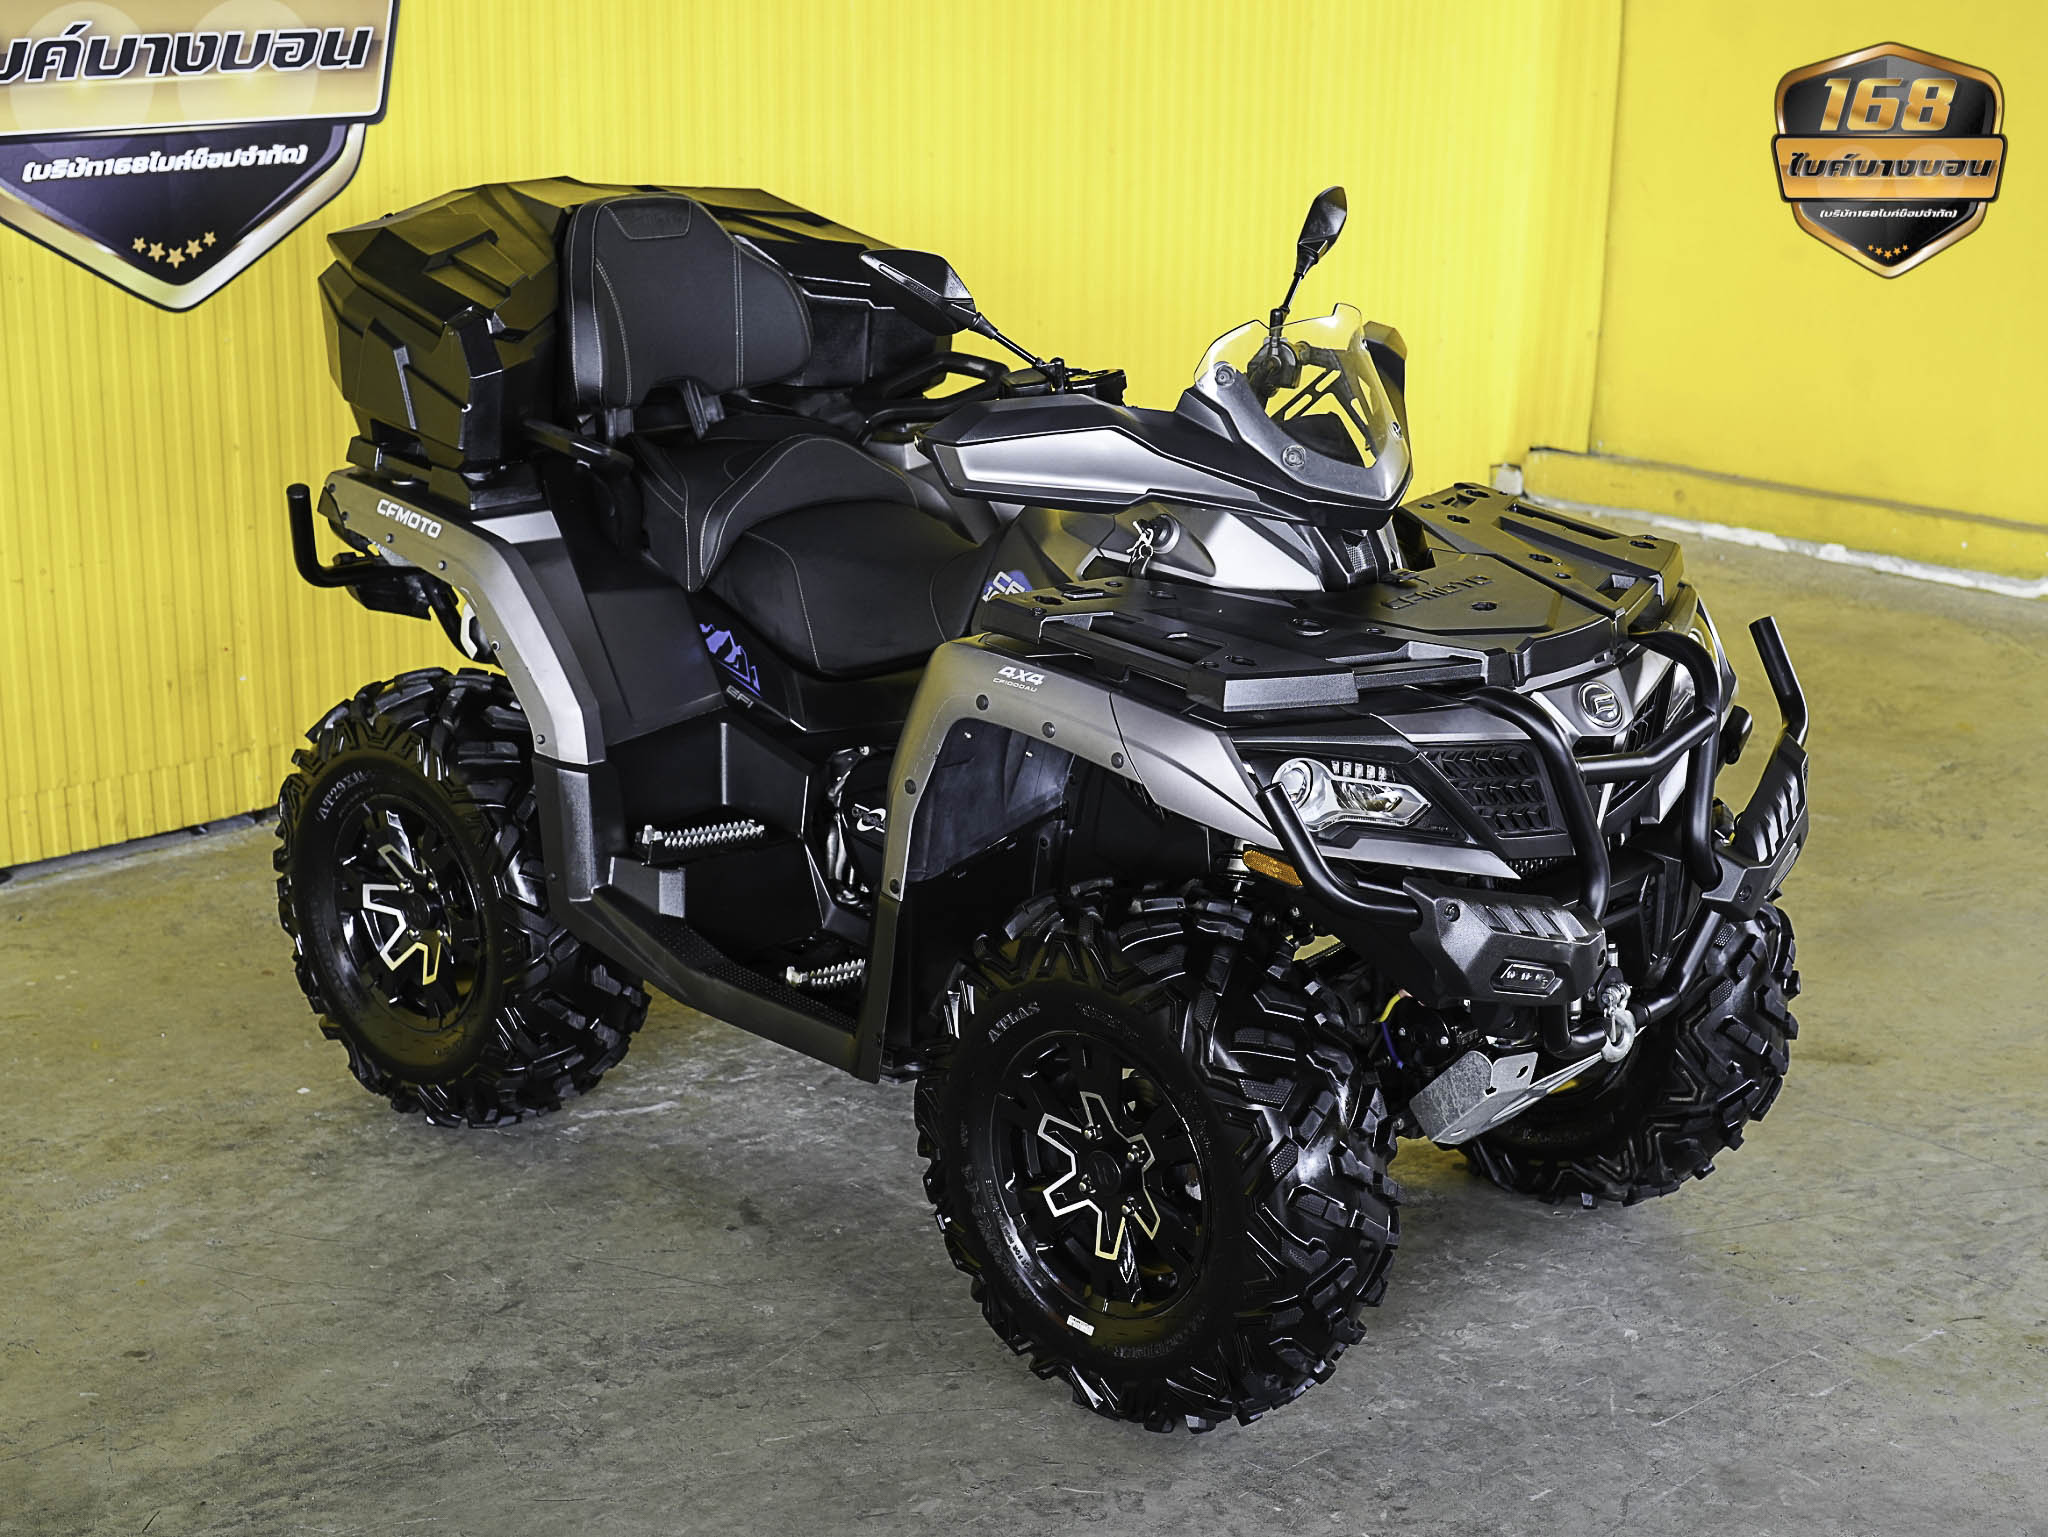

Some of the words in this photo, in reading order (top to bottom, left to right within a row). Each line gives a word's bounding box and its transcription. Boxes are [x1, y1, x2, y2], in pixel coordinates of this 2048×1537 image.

[376, 498, 442, 539] CFMOTO
[997, 666, 1045, 686] 4X4
[725, 684, 754, 709] EFI
[988, 1001, 1041, 1043] ATLAS
